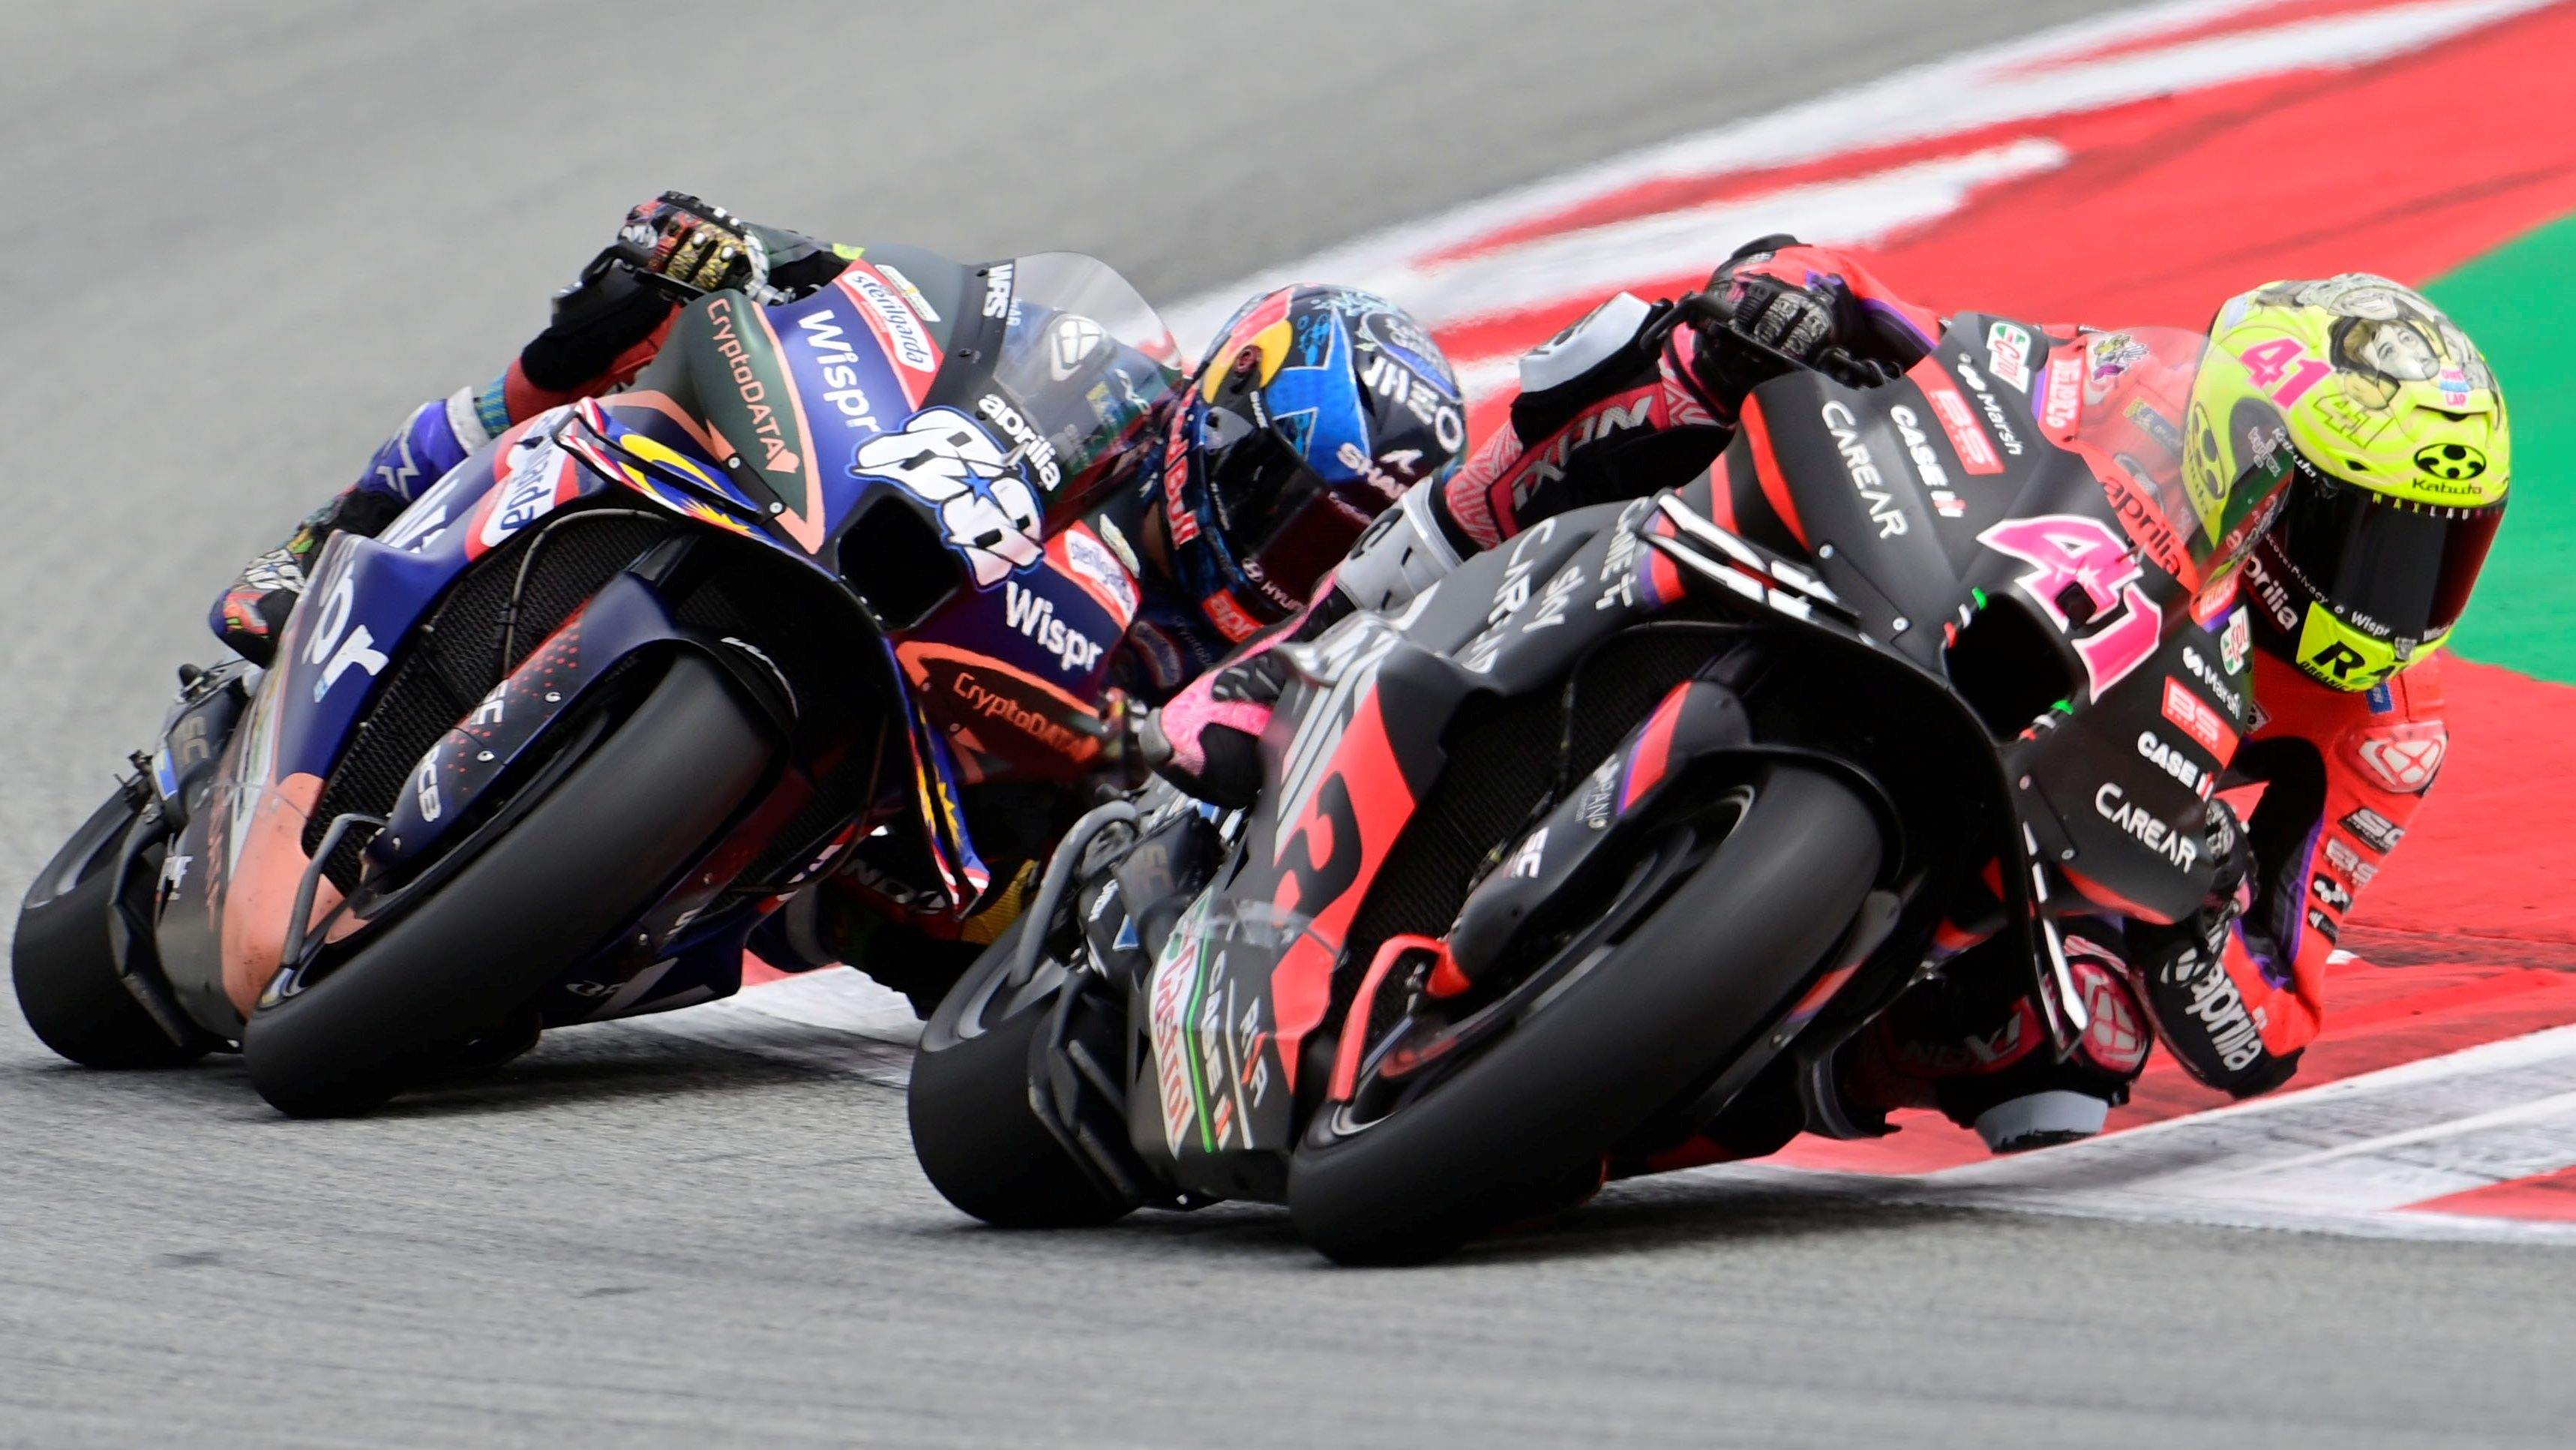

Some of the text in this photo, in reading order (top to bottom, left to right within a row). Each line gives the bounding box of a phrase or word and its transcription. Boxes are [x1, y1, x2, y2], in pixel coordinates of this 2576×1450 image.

[706, 298, 787, 459] CryptoDATA
[799, 309, 881, 433] Wispr
[2239, 338, 2332, 410] 41
[978, 393, 1061, 491] aprilia
[1822, 401, 1909, 539] CAREAR
[1890, 405, 1949, 488] CASE
[1977, 393, 2024, 455] Marsh
[2101, 475, 2182, 580] aprilia
[2412, 477, 2482, 495] Kabuto
[1006, 581, 1103, 672] Wispr
[1976, 513, 2163, 705] 41
[2350, 610, 2392, 637] Wispr
[2137, 730, 2199, 789] CASE
[2095, 782, 2196, 875] CAREAR
